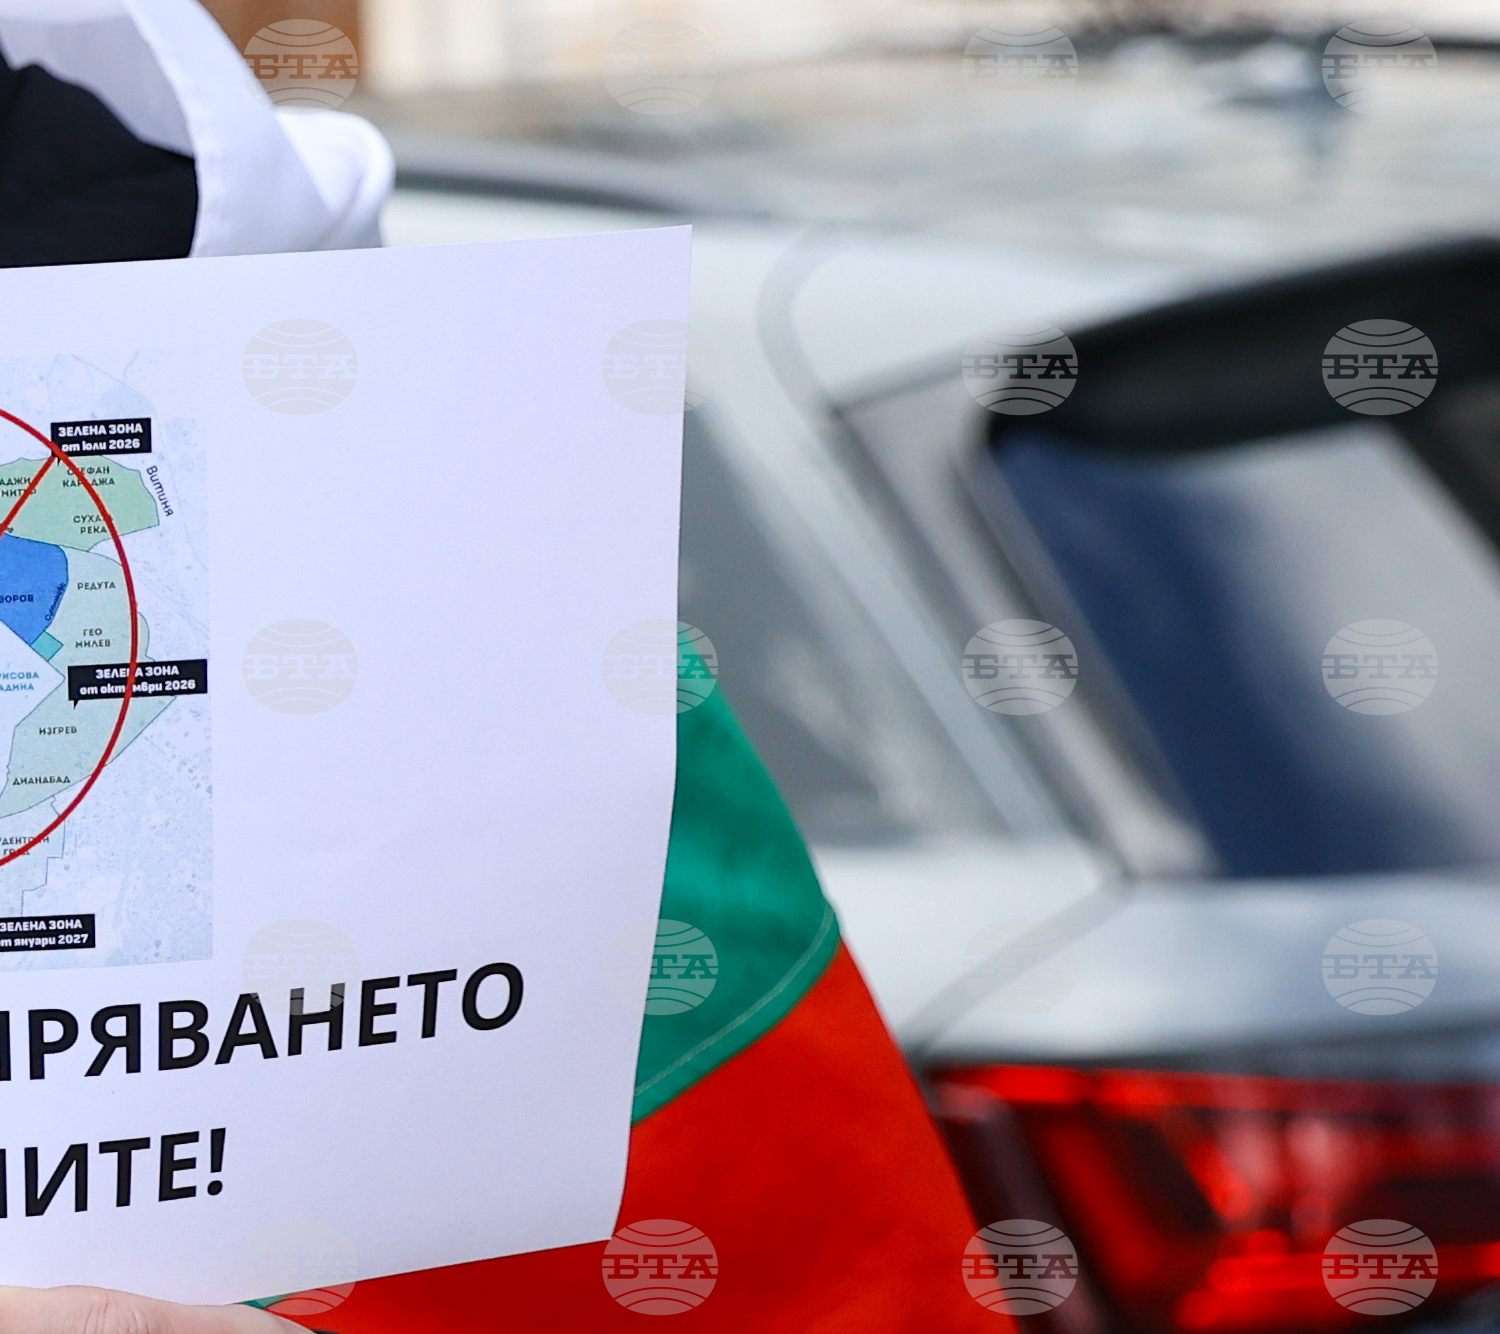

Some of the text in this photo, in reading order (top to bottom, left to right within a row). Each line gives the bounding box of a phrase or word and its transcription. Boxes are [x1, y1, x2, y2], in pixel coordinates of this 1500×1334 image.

[58, 423, 144, 437] ЗЕЛЕНА ЗОНА
[61, 439, 140, 452] от юли 2026
[66, 465, 110, 475] СЕФАН
[62, 477, 115, 488] КАРДЖА
[146, 465, 174, 517] Витиня
[73, 514, 113, 524] СУХА
[80, 525, 108, 535] РЕКА
[77, 581, 116, 590] РЕДУТА
[83, 628, 102, 637] ГЕО
[145, 665, 180, 677] ЗОНА
[80, 679, 196, 695] от октмври 2026
[38, 726, 78, 735] ИЗГРЕВ
[12, 775, 71, 786] ДИАНАБАД
[48, 919, 82, 930] ЗОНА
[14, 936, 56, 949] януари
[58, 934, 88, 945] 2027
